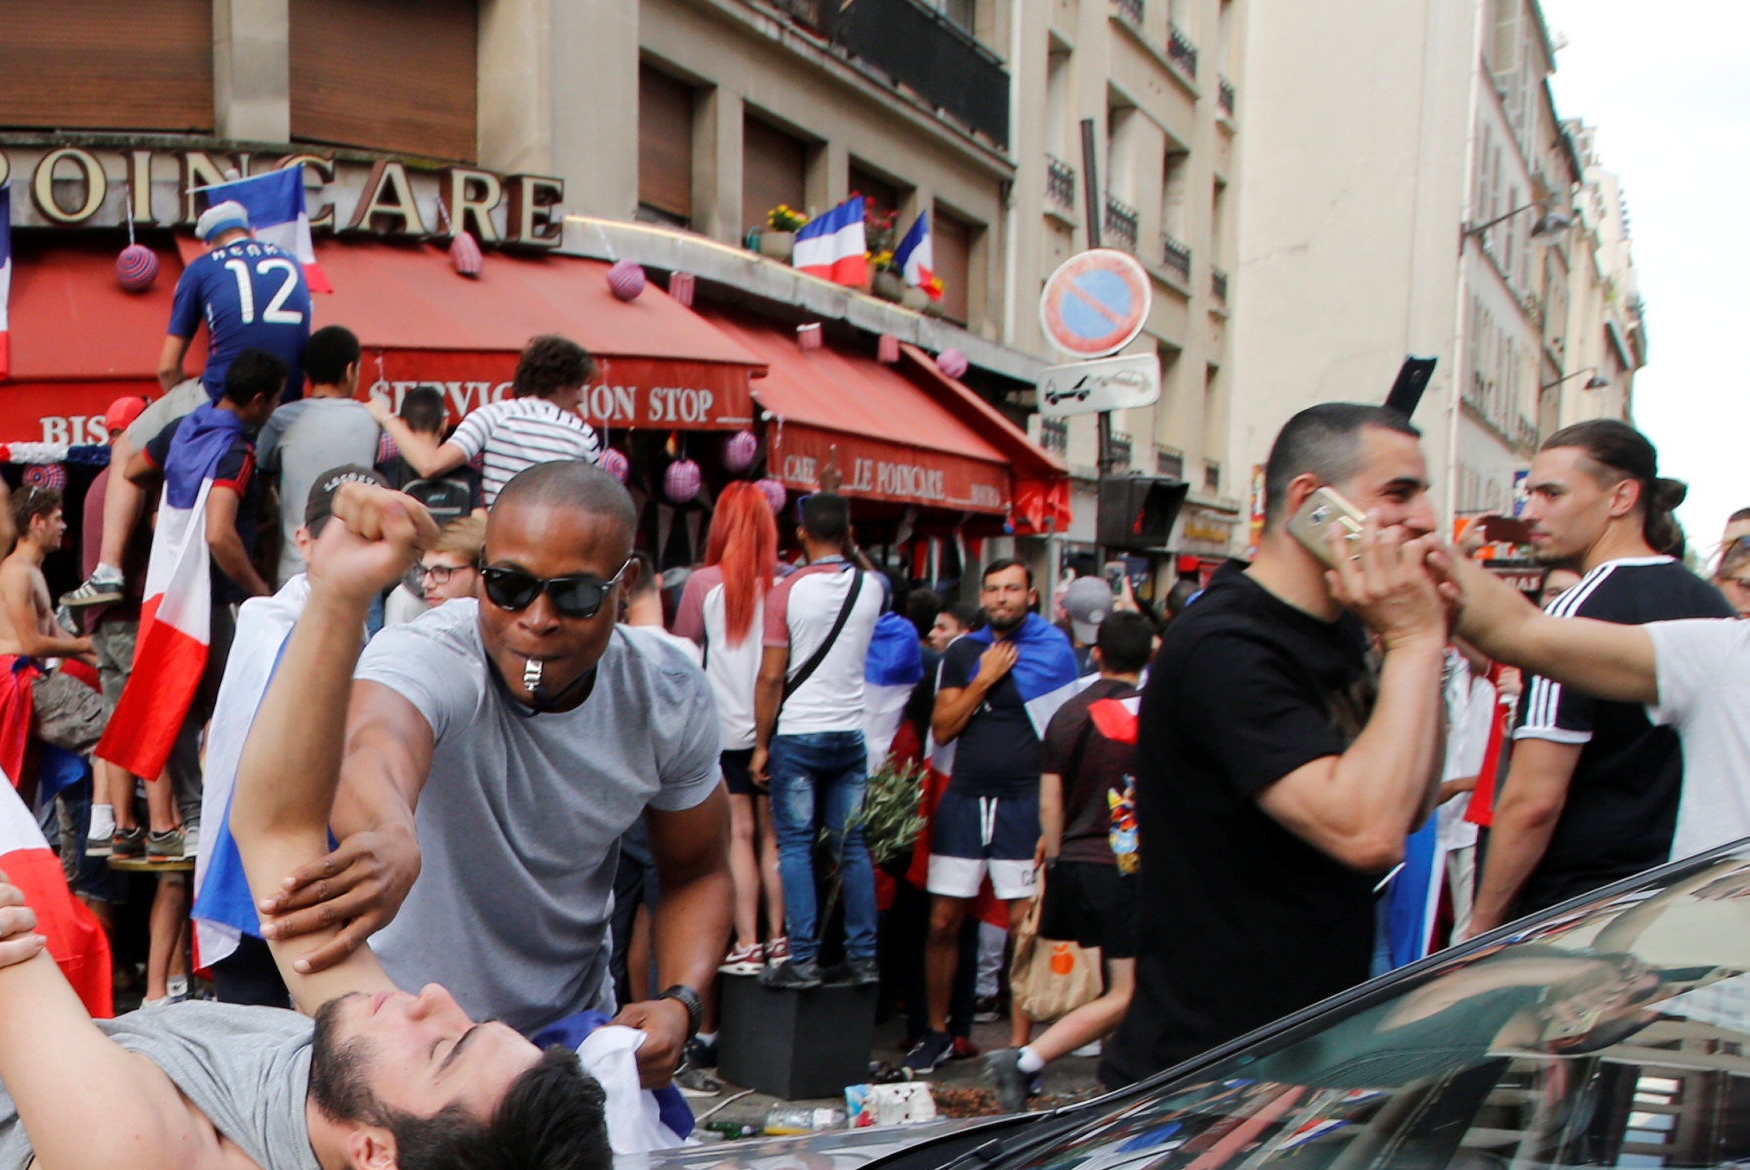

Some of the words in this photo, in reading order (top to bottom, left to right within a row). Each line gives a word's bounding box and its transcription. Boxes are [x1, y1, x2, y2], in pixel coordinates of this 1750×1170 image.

[223, 257, 304, 325] 12
[648, 384, 714, 423] STOP
[783, 454, 818, 484] CAFE
[853, 457, 873, 492] LE
[877, 460, 945, 500] POINCARE
